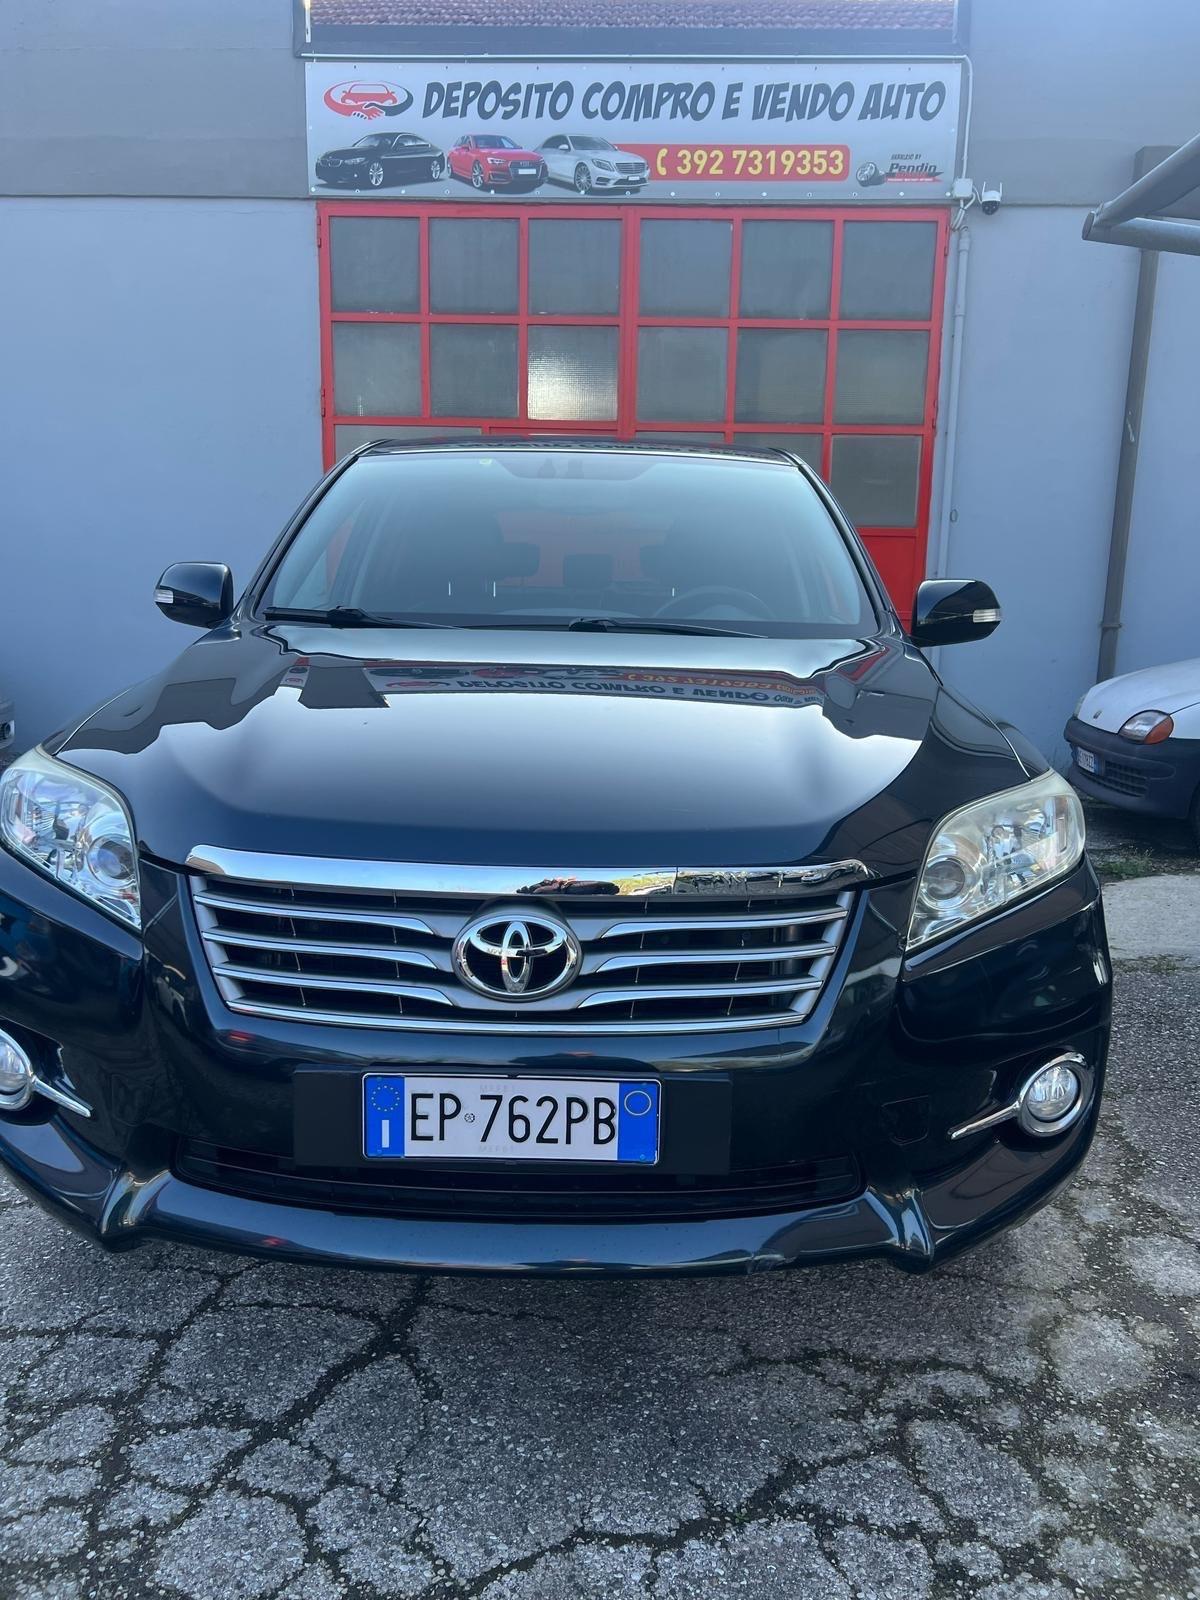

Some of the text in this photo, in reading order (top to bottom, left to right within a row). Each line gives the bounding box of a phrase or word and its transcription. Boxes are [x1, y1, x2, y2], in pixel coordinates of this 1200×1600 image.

[421, 80, 947, 123] DEPOSITO COMPRO E VENDO AUTO
[676, 149, 844, 175] 392 7319353
[410, 1092, 462, 1142] EP
[480, 1094, 617, 1145] 762PB
